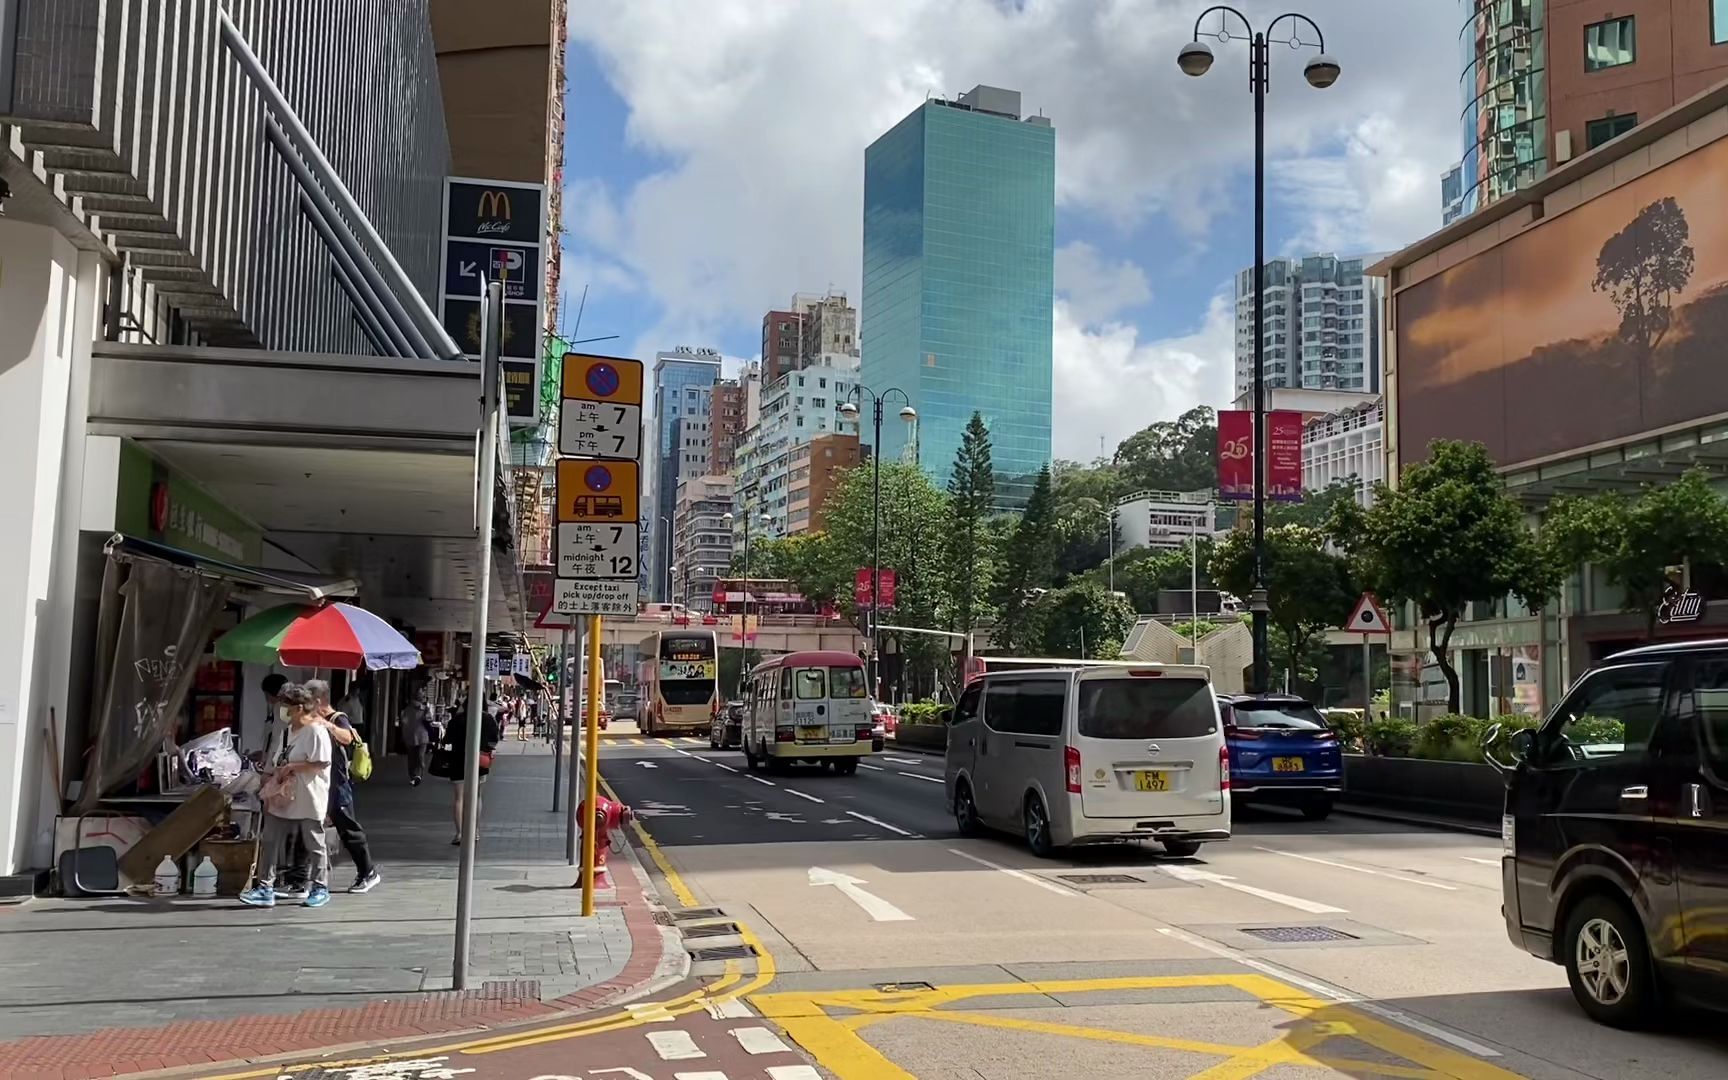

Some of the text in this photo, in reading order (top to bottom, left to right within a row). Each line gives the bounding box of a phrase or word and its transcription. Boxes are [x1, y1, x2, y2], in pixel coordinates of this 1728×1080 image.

[575, 407, 626, 424] 上午 7
[579, 431, 594, 439] pm
[574, 435, 625, 453] 下午 7
[1220, 436, 1249, 460] 25
[572, 526, 623, 544] 上午 7
[563, 553, 604, 562] midnight
[572, 556, 632, 574] 午夜 12
[574, 582, 620, 591] Except taxi
[563, 591, 580, 599] pick
[582, 592, 615, 600] up/drop
[557, 600, 632, 612] 的士上落客除外
[1144, 771, 1160, 780] FM
[1139, 780, 1165, 790] 1497
